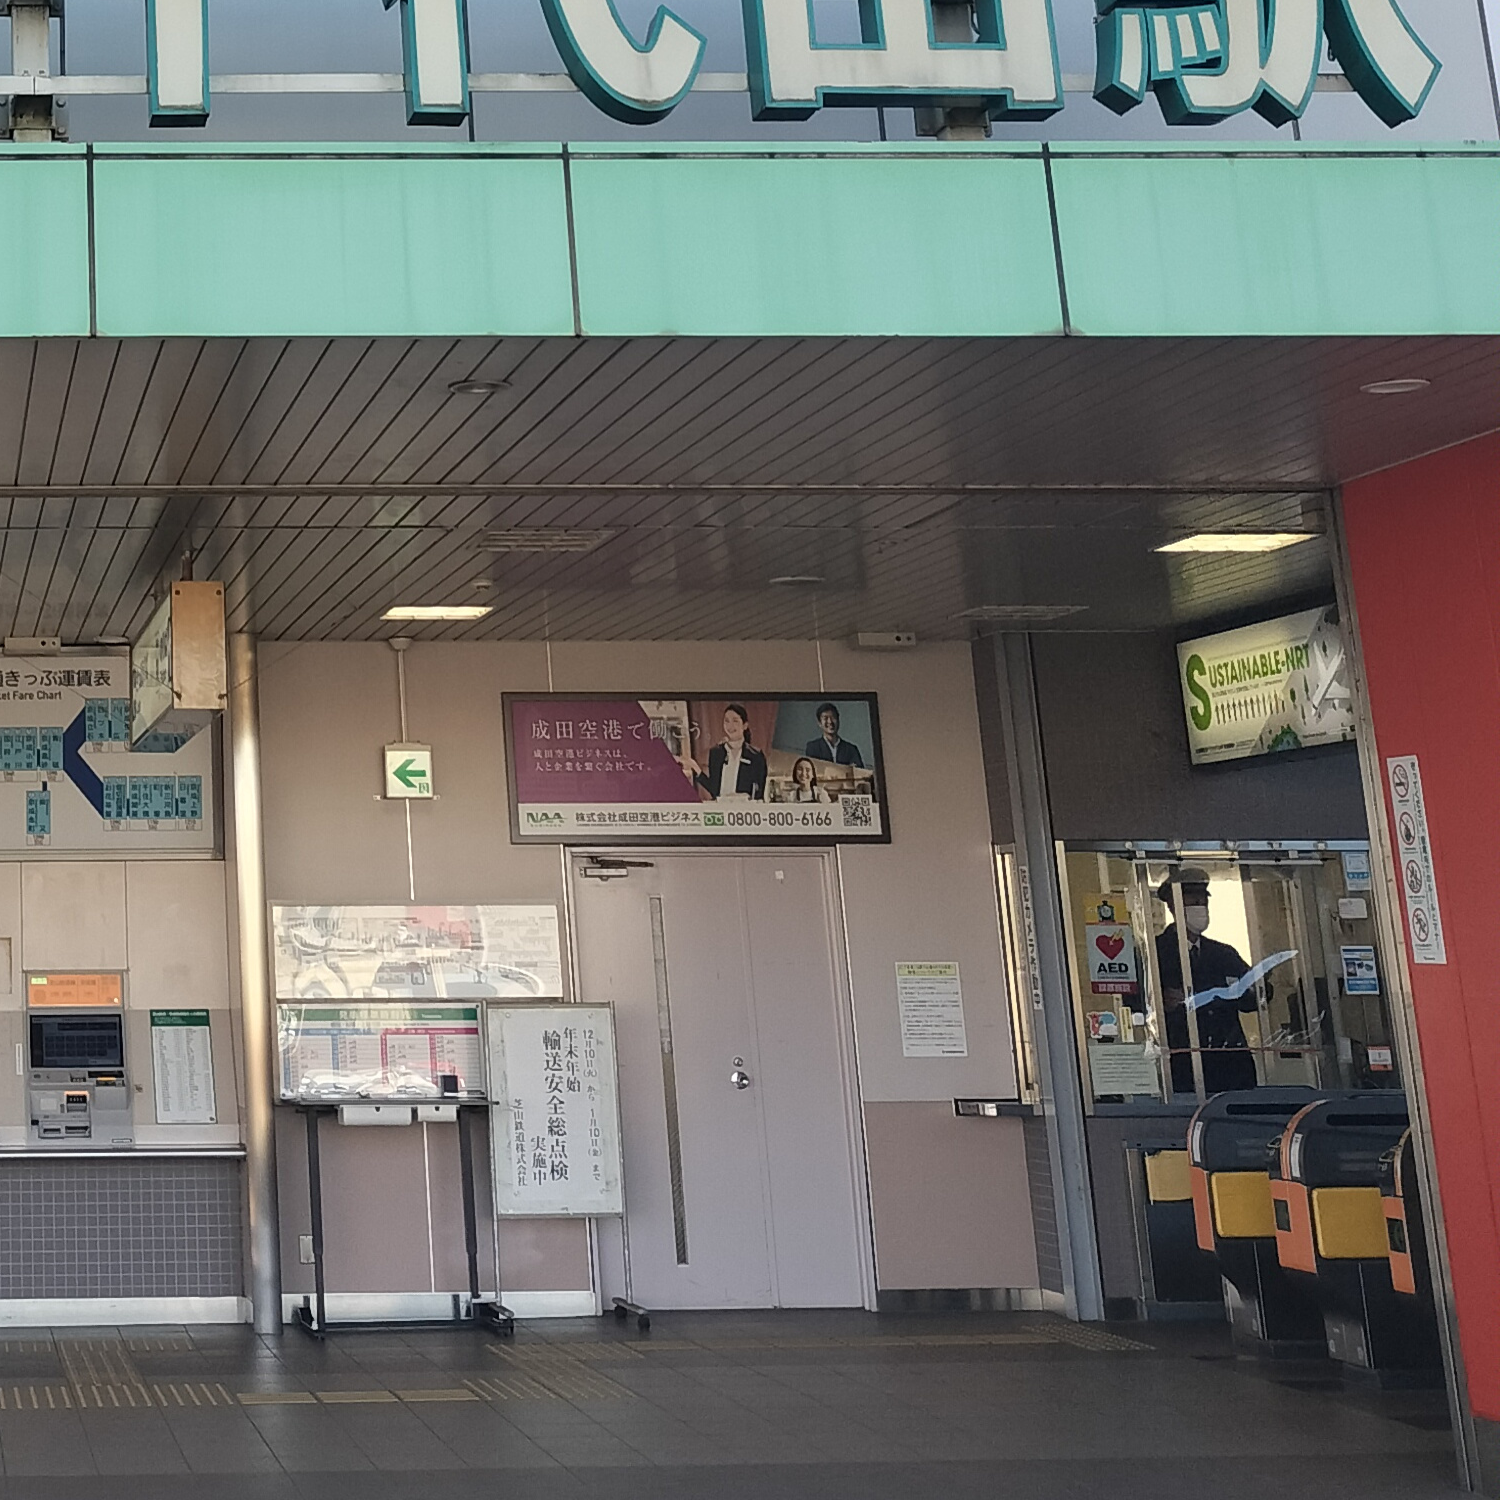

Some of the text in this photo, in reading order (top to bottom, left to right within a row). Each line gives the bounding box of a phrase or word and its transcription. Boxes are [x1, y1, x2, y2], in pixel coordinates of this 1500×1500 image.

[12, 690, 34, 700] Fare
[36, 690, 62, 700] Chart
[531, 719, 701, 740] 成田空港で働こう
[533, 749, 628, 759] 成田空港ビジネスは、
[526, 812, 566, 824] NAA
[575, 812, 701, 823] 株式会社成田空港ビジネス
[727, 811, 832, 827] 0800-800-6166
[1097, 962, 1129, 973] AED
[563, 1027, 581, 1093] 年末年始
[542, 1030, 569, 1181] 輸送安全総点検
[510, 1098, 527, 1187] 芝山鉄道株式会社
[531, 1135, 547, 1186] 実施中
